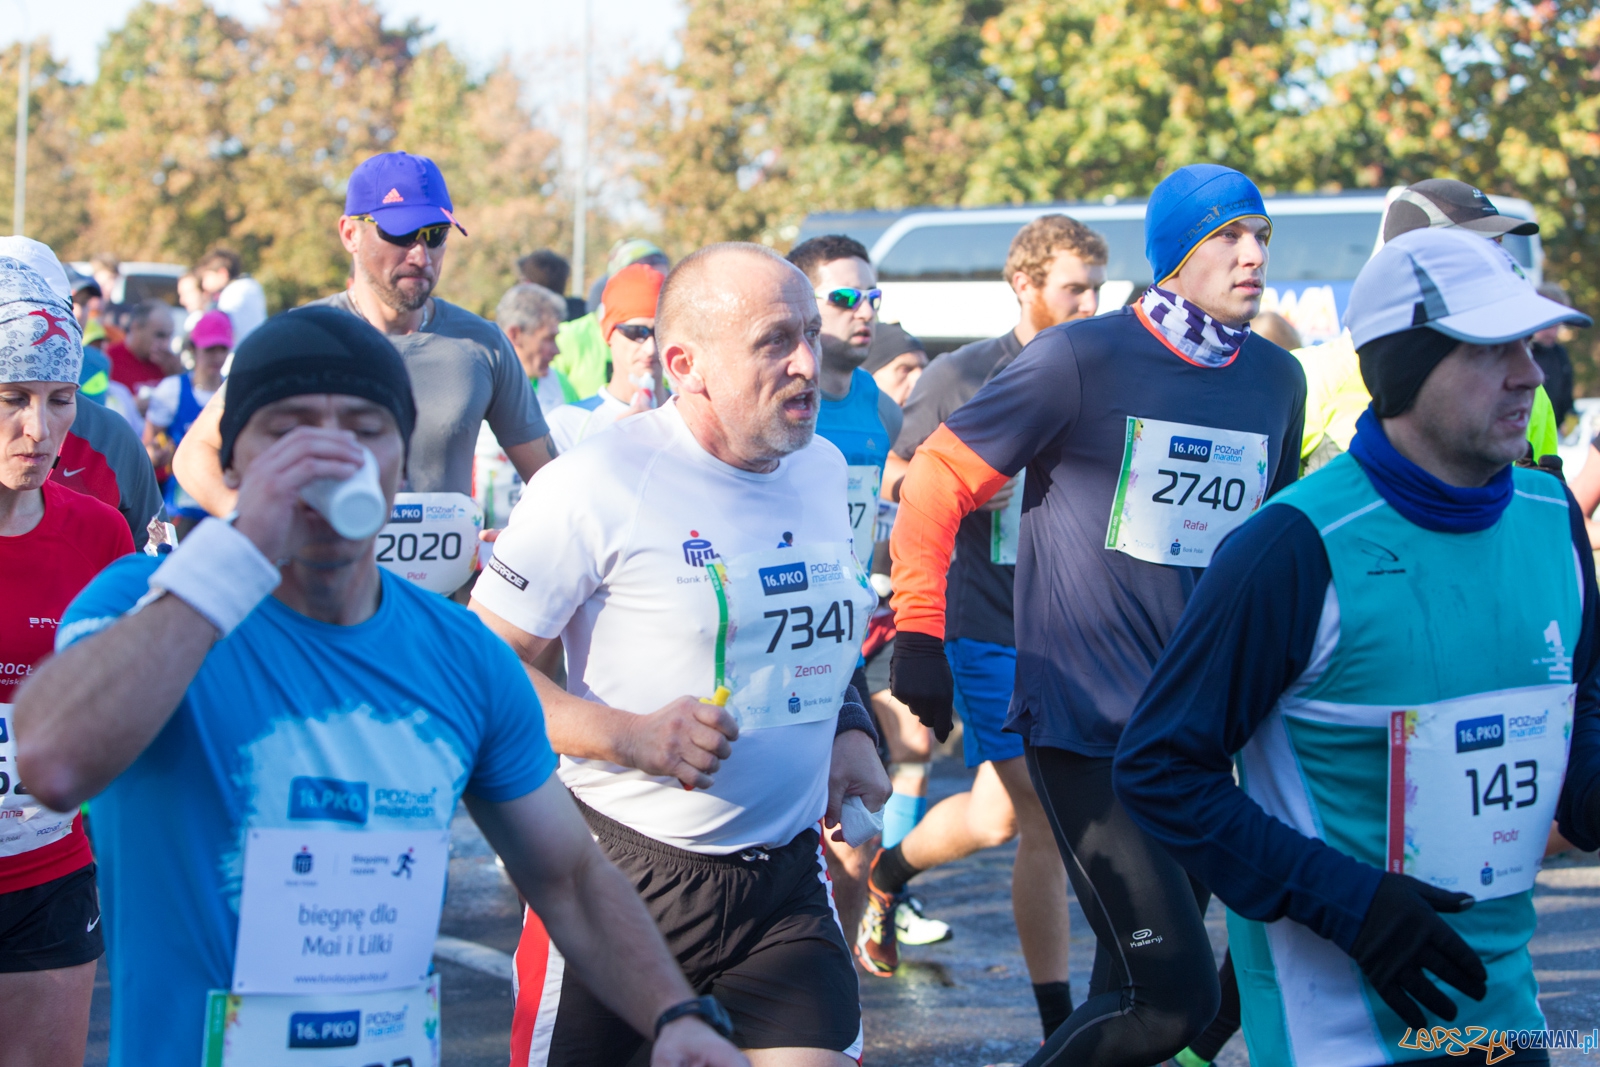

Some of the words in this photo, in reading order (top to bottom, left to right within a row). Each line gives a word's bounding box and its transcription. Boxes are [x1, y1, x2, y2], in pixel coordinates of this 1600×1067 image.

[1173, 442, 1186, 454] 16.
[1188, 444, 1208, 456] PKO
[1213, 453, 1242, 463] maraton
[1152, 469, 1246, 512] 2740
[401, 508, 421, 520] PKO
[1183, 519, 1208, 532] Rafał
[376, 532, 462, 562] 2020
[407, 571, 427, 581] Piotr
[676, 574, 702, 585] Bank
[763, 574, 779, 588] 16.
[780, 570, 804, 586] PKO
[812, 571, 844, 584] maraton
[763, 599, 854, 654] 7341
[0, 662, 33, 676] OCŁ
[794, 663, 832, 678] Zenon
[803, 698, 817, 708] Bank
[1459, 728, 1476, 744] 16.
[1477, 724, 1501, 740] PKO
[1465, 759, 1538, 817] 143
[321, 788, 365, 814] PKO
[1493, 828, 1520, 845] Piotr
[298, 903, 365, 931] biegnę
[369, 903, 398, 925] dla
[302, 936, 342, 956] Mai
[347, 935, 353, 954] i
[358, 934, 393, 954] Lilki
[295, 1022, 320, 1039] 16.
[321, 1020, 357, 1038] PKO
